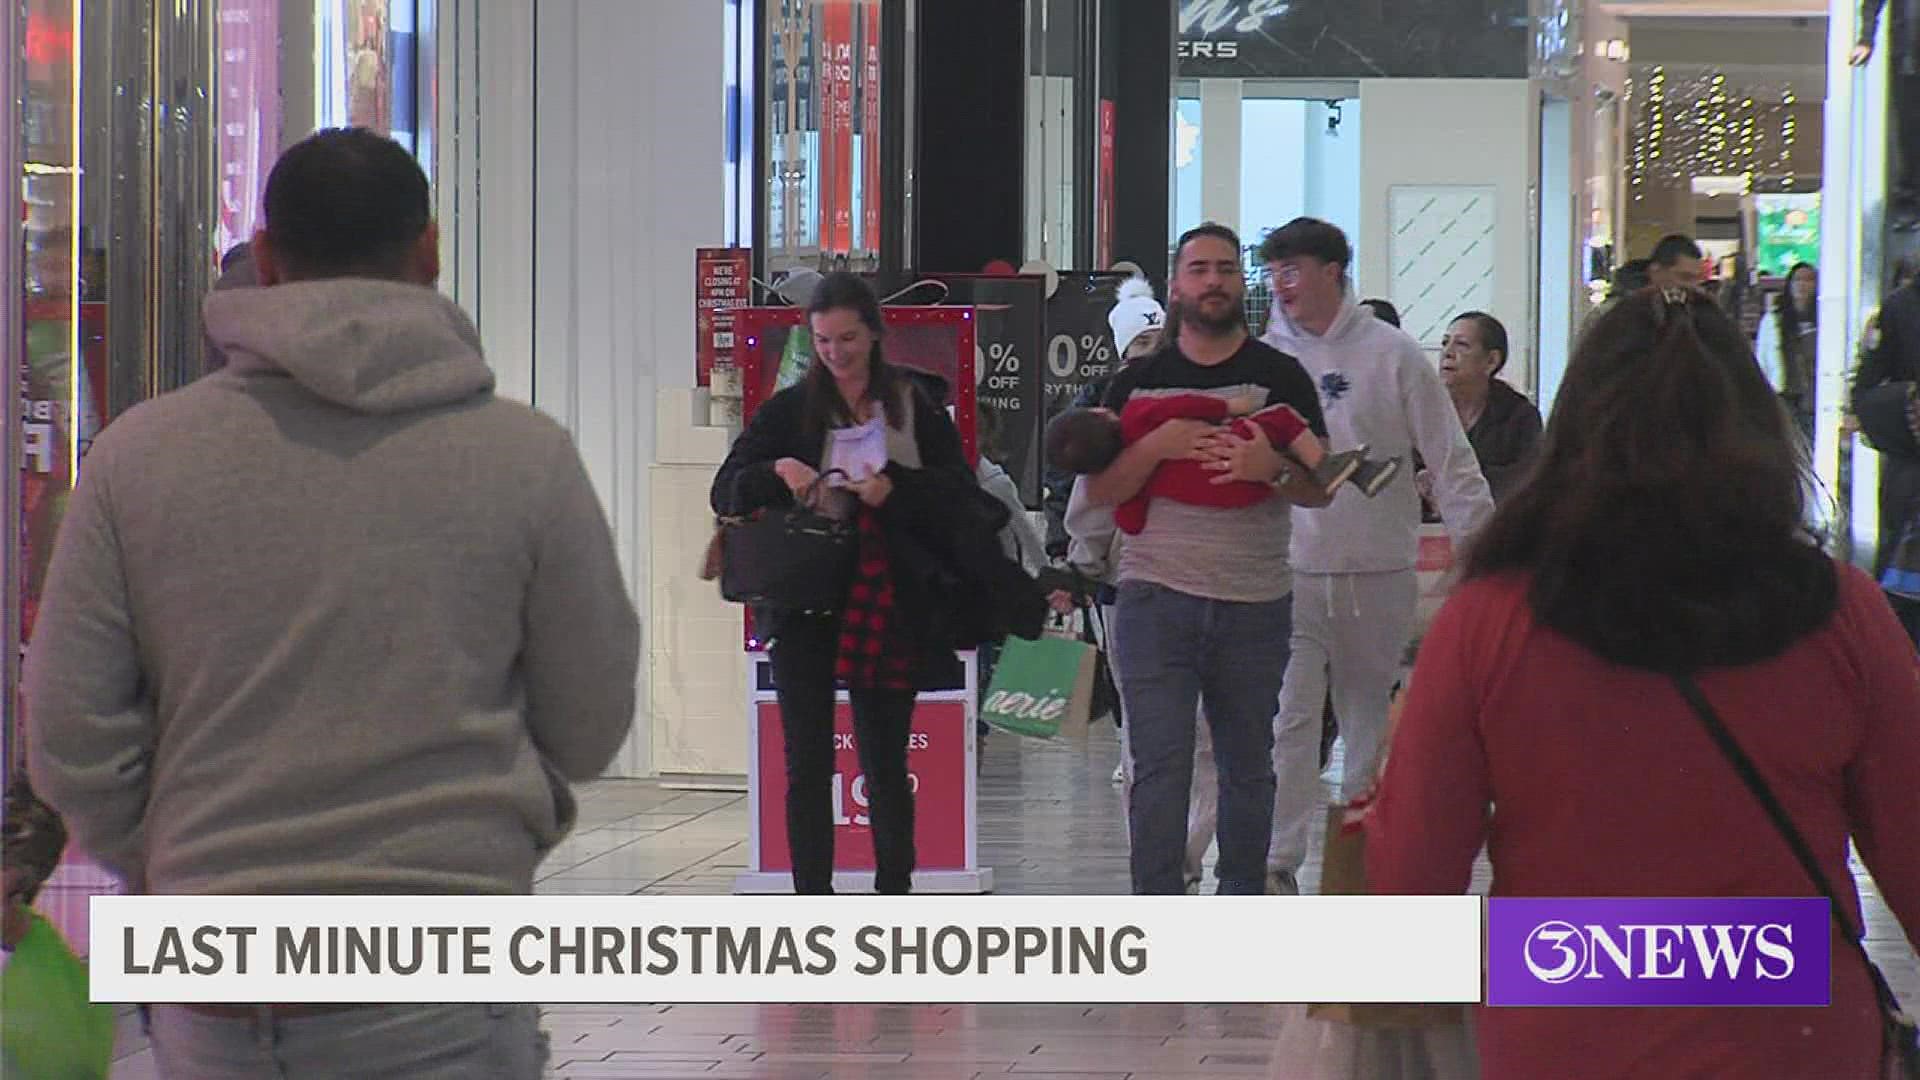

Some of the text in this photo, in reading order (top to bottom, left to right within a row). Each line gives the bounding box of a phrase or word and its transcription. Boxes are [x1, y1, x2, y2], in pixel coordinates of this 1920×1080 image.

[1177, 41, 1238, 58] ERS
[1080, 365, 1110, 377] OFF
[988, 376, 1020, 390] OFF
[983, 689, 1067, 720] aerie
